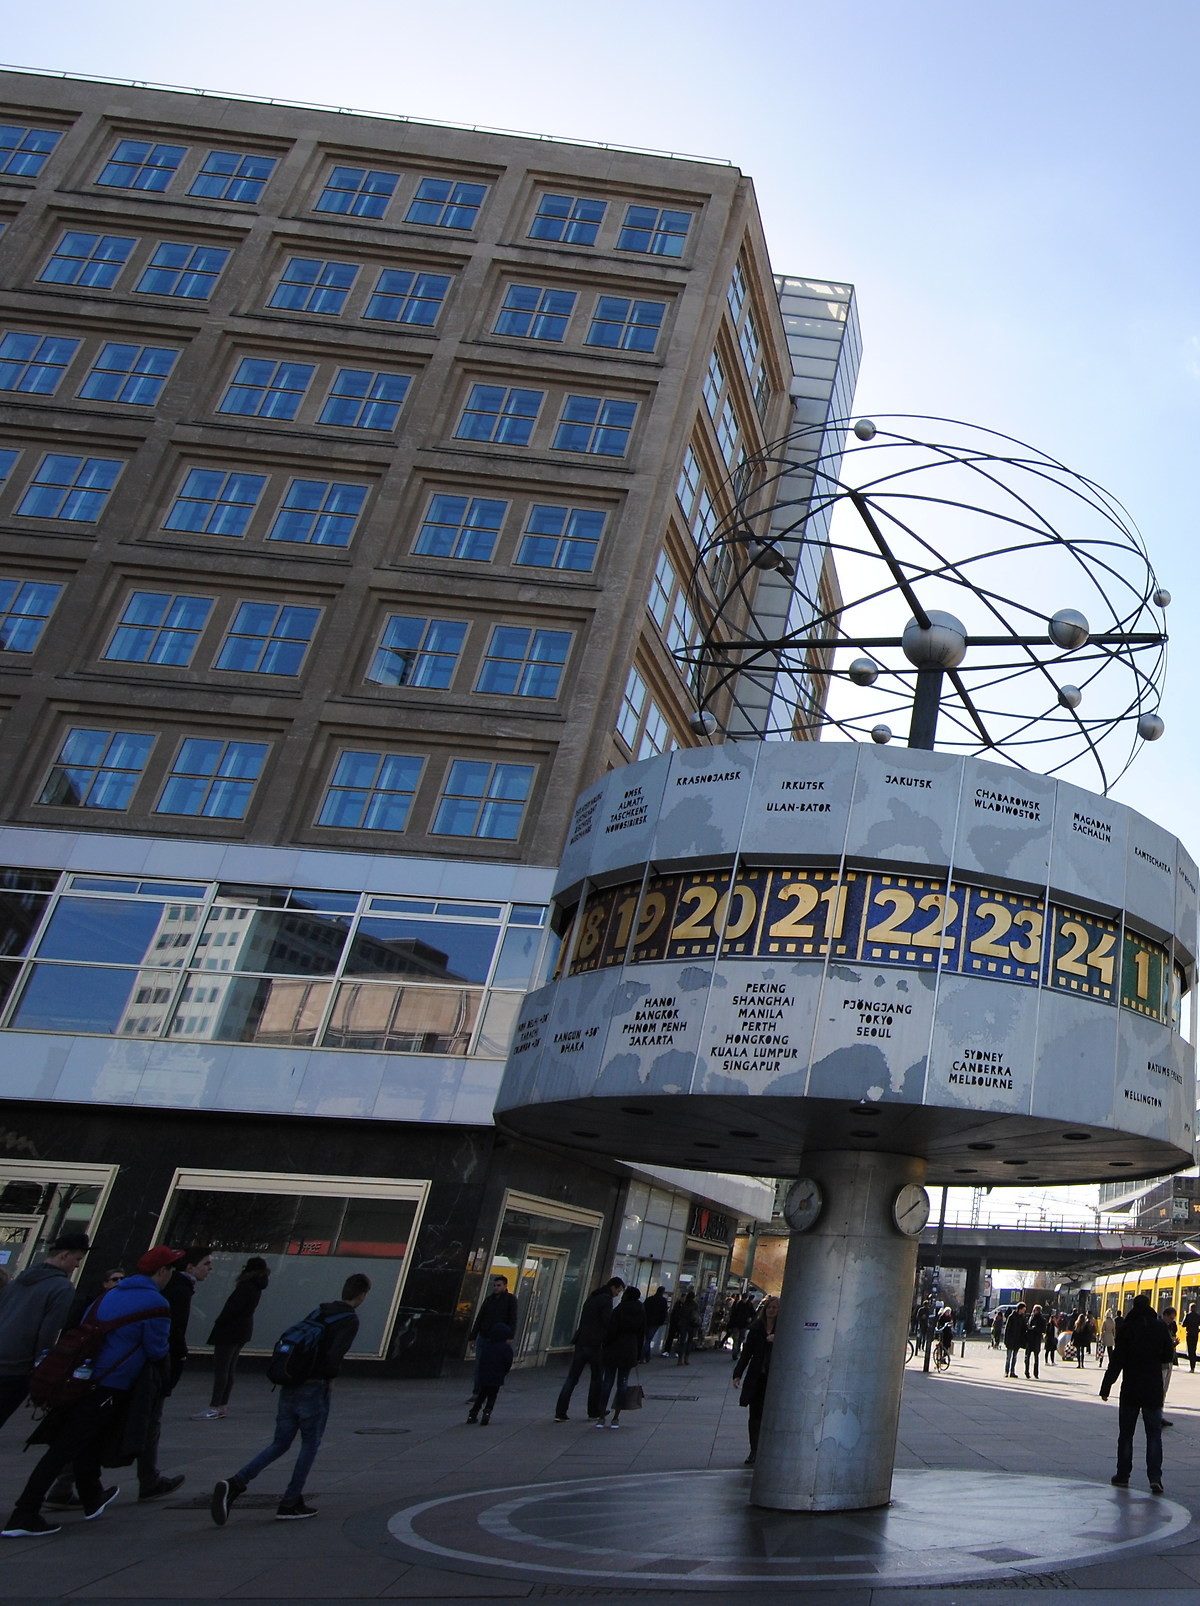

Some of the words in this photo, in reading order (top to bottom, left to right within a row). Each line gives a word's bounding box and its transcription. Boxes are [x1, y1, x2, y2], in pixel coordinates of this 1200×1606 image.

[676, 771, 741, 786] KRASNOJARSK
[781, 781, 825, 790] IRKUTSK
[885, 775, 932, 789] JAKUTSK
[624, 787, 642, 798] OMSK
[618, 796, 645, 811] ALMATY
[975, 789, 1041, 811] CHABAROWSK
[610, 805, 648, 822] TASCHKENT
[766, 802, 832, 813] ULAN-BATOR
[974, 799, 1041, 822] WLADIWOSTOK
[605, 815, 647, 834] NOWOSIBIRSK
[1073, 813, 1112, 833] MAGADAN
[1073, 822, 1112, 843] SACHALIN
[1134, 847, 1172, 874] KAMTSCHATKA
[672, 884, 757, 940] 20
[769, 882, 848, 940] 21
[614, 892, 666, 949] 19
[867, 888, 958, 950] 22
[970, 902, 1042, 965] 23
[1056, 921, 1115, 986] 24
[1134, 949, 1151, 1000] 1
[745, 983, 786, 993] PEKING
[644, 998, 676, 1008] HANOI
[732, 995, 795, 1006] SHANGHAI
[843, 999, 912, 1015] PJÖNGJANG
[635, 1009, 680, 1020] BANGKOK
[738, 1008, 783, 1019] MANILA
[859, 1014, 893, 1025] TOKYO
[622, 1022, 658, 1034] PHNOM
[660, 1021, 687, 1033] PENH
[742, 1022, 776, 1032] PERTH
[856, 1027, 891, 1039] SEOUL
[553, 1030, 581, 1043] RANGUN
[629, 1034, 674, 1047] JAKARTA
[725, 1034, 789, 1045] HONGKONG
[560, 1042, 584, 1054] DHAKA
[710, 1046, 749, 1057] KUALA
[754, 1048, 798, 1059] LUMPUR
[964, 1049, 1004, 1063] SYDNEY
[723, 1060, 781, 1071] SINGAPUR
[952, 1061, 1012, 1077] CANBERRA
[949, 1073, 1013, 1090] MELBOURNE
[1124, 1089, 1162, 1108] WELLINGTON
